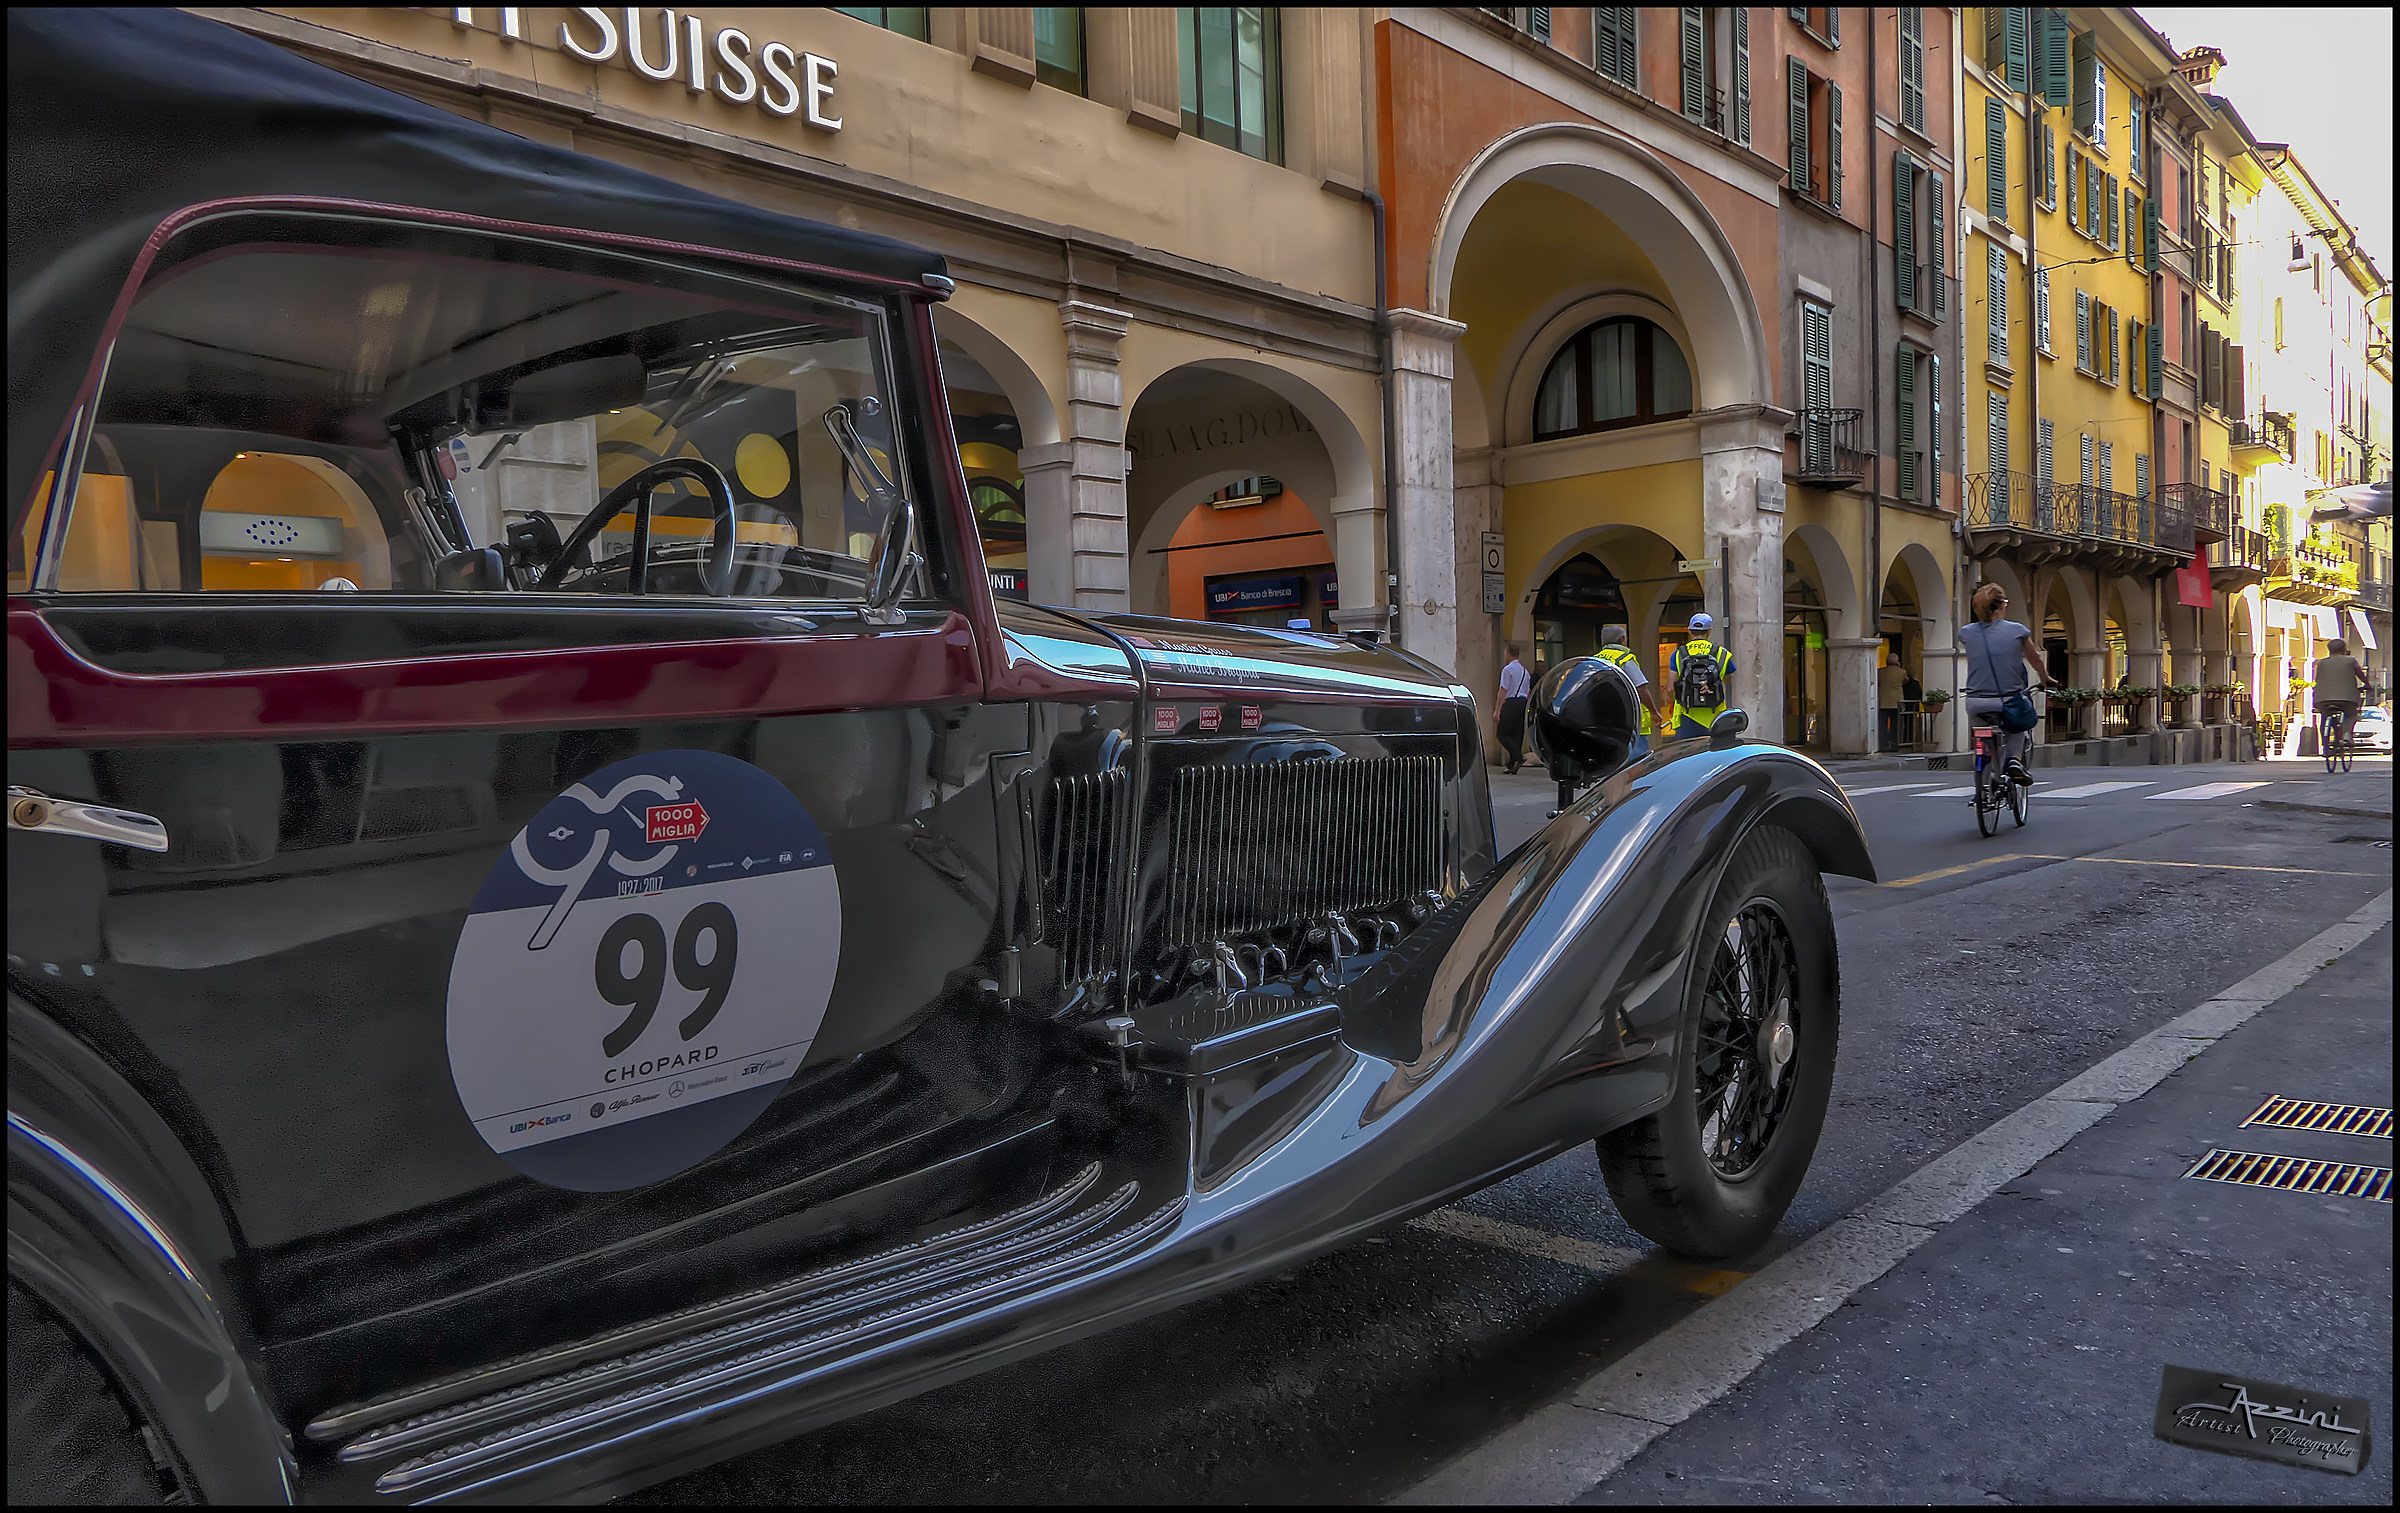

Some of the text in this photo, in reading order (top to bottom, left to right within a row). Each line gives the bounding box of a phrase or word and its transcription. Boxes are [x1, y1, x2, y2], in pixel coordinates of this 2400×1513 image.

[558, 7, 844, 133] SUISSE
[1214, 588, 1292, 603] UBI Banco di Brescia
[1158, 710, 1174, 718] 1000
[1202, 709, 1217, 717] 1000
[1244, 709, 1257, 717] 1000
[1157, 720, 1175, 729] MIGLIA
[1201, 719, 1217, 727] MIGLIA
[1243, 718, 1258, 726] MIGLIA
[654, 808, 693, 822] 1000
[652, 823, 696, 838] MIGLIA
[618, 876, 664, 896] 1927 2017
[594, 901, 739, 1059] 99
[604, 1045, 719, 1084] CHOPARD
[510, 1112, 572, 1134] UBI Banca
